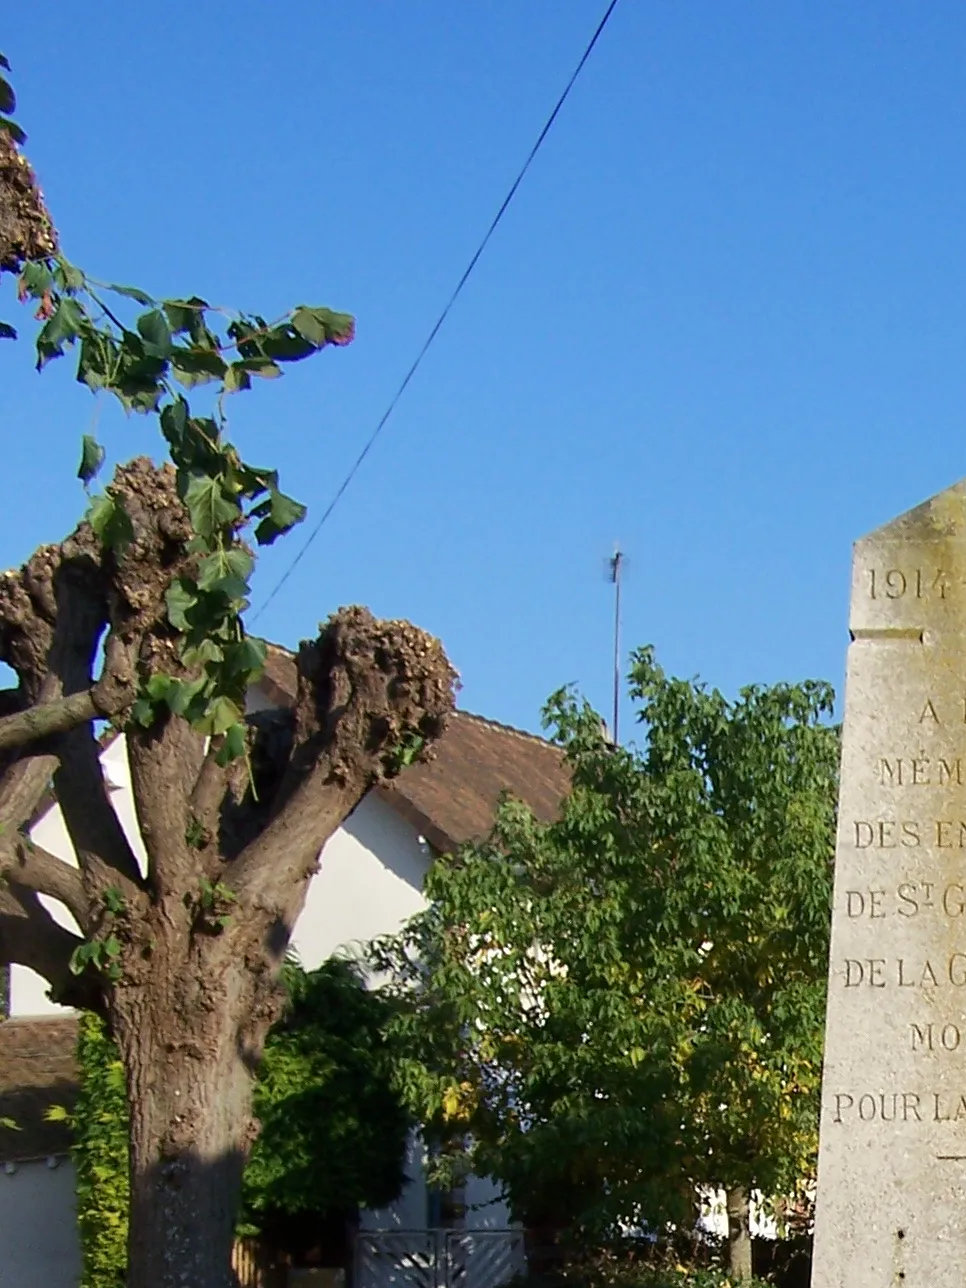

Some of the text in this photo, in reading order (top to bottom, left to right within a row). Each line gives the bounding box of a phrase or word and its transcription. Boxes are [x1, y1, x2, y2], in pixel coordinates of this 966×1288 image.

[918, 698, 940, 724] A
[853, 820, 921, 850] DES
[845, 890, 886, 919] DE
[844, 959, 886, 988] DE
[897, 958, 940, 988] LA
[833, 1093, 922, 1123] POUR
